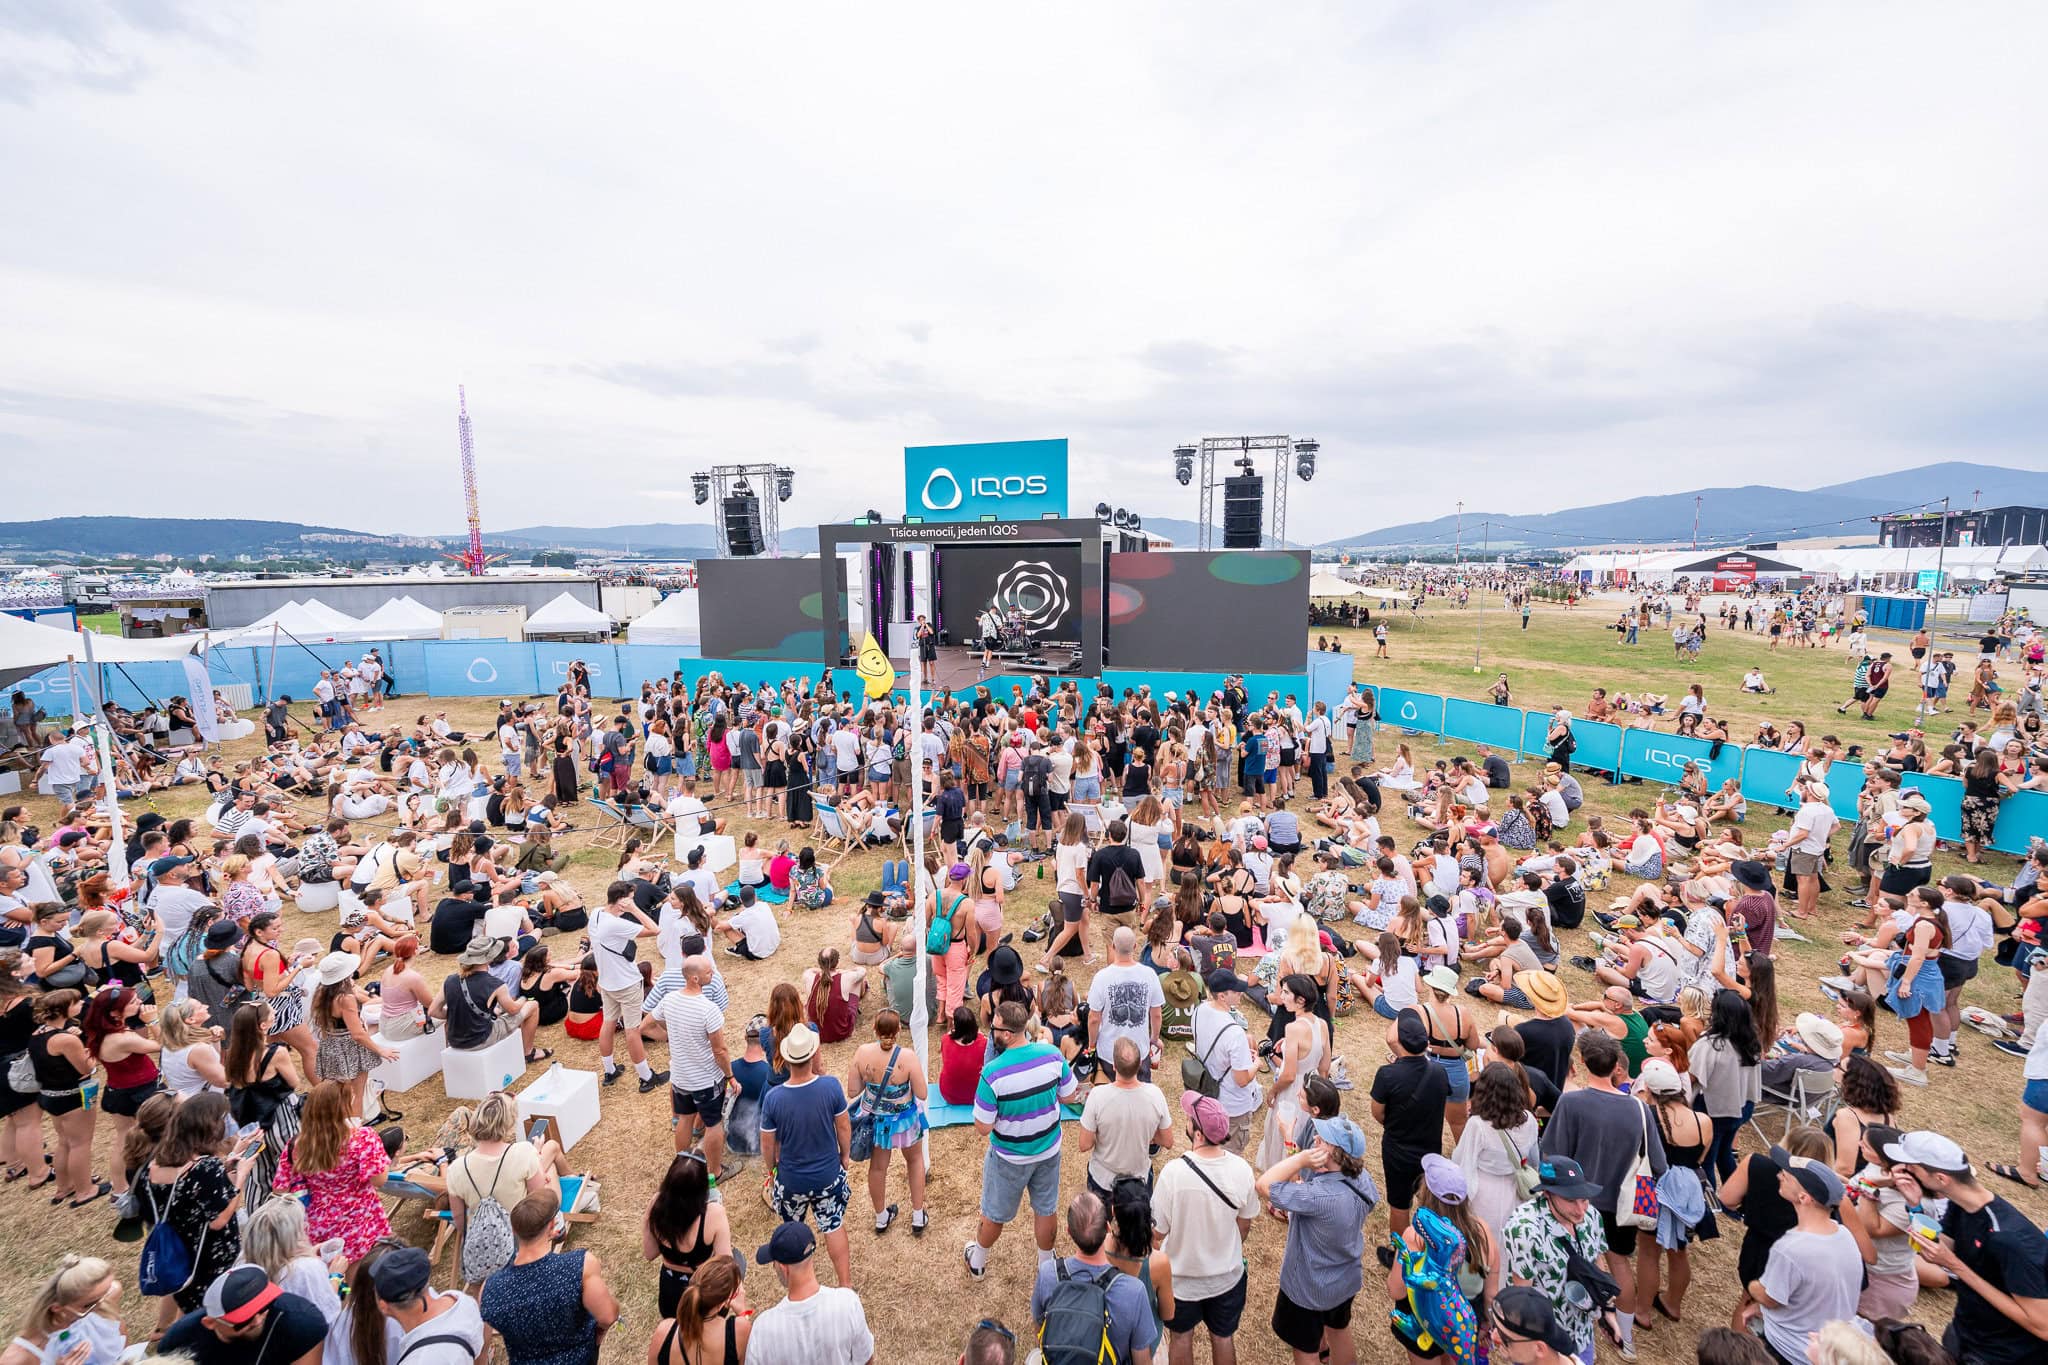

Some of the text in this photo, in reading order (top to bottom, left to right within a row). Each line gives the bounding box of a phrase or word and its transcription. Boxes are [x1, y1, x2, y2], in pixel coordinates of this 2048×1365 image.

[971, 475, 1048, 498] IQOS
[889, 525, 1018, 540] Tisíce emocií, jeden IQOS
[552, 660, 601, 677] IQS
[1645, 748, 1712, 773] IQOS
